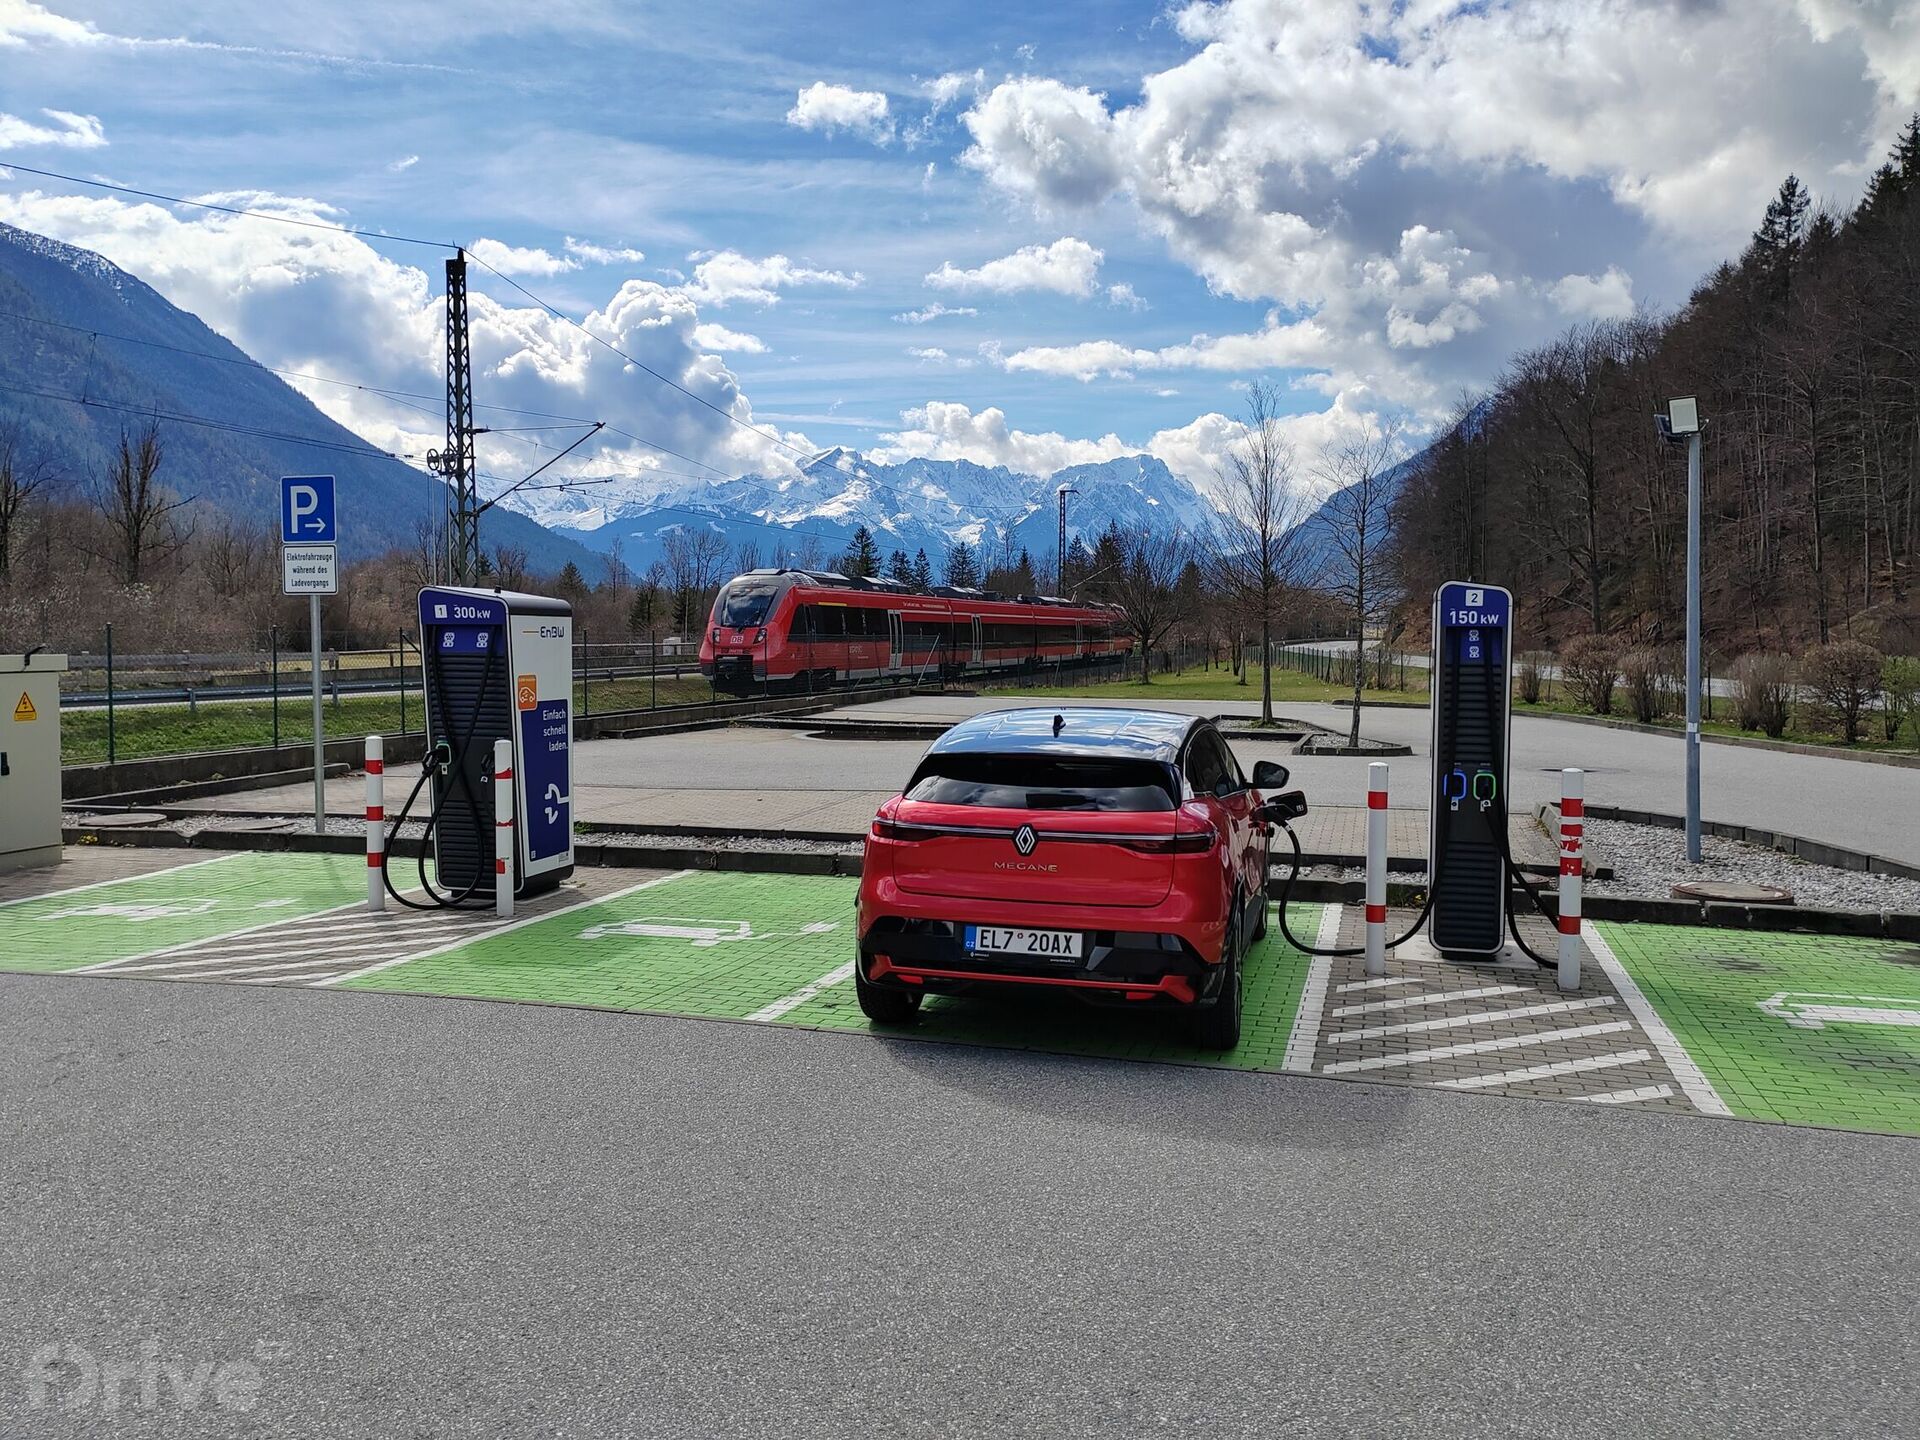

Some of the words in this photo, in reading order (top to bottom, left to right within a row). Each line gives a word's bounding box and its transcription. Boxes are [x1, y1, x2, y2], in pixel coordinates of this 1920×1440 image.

[290, 485, 318, 533] P
[286, 553, 333, 563] Elektrofahrzeuge
[292, 565, 316, 574] während
[317, 565, 328, 574] des
[291, 578, 329, 589] Ladevorgangs
[1471, 592, 1478, 603] 2
[453, 606, 476, 619] 300
[477, 609, 491, 619] kW
[1449, 610, 1478, 625] 150
[1480, 614, 1499, 625] kW
[539, 626, 565, 638] EnBW
[543, 708, 567, 721] Einfach
[543, 723, 567, 737] schnell
[548, 740, 569, 752] laden.
[994, 862, 1058, 872] MEGANE
[965, 940, 975, 948] CZ
[979, 929, 1014, 949] EL7
[1027, 932, 1073, 954] 20AX
